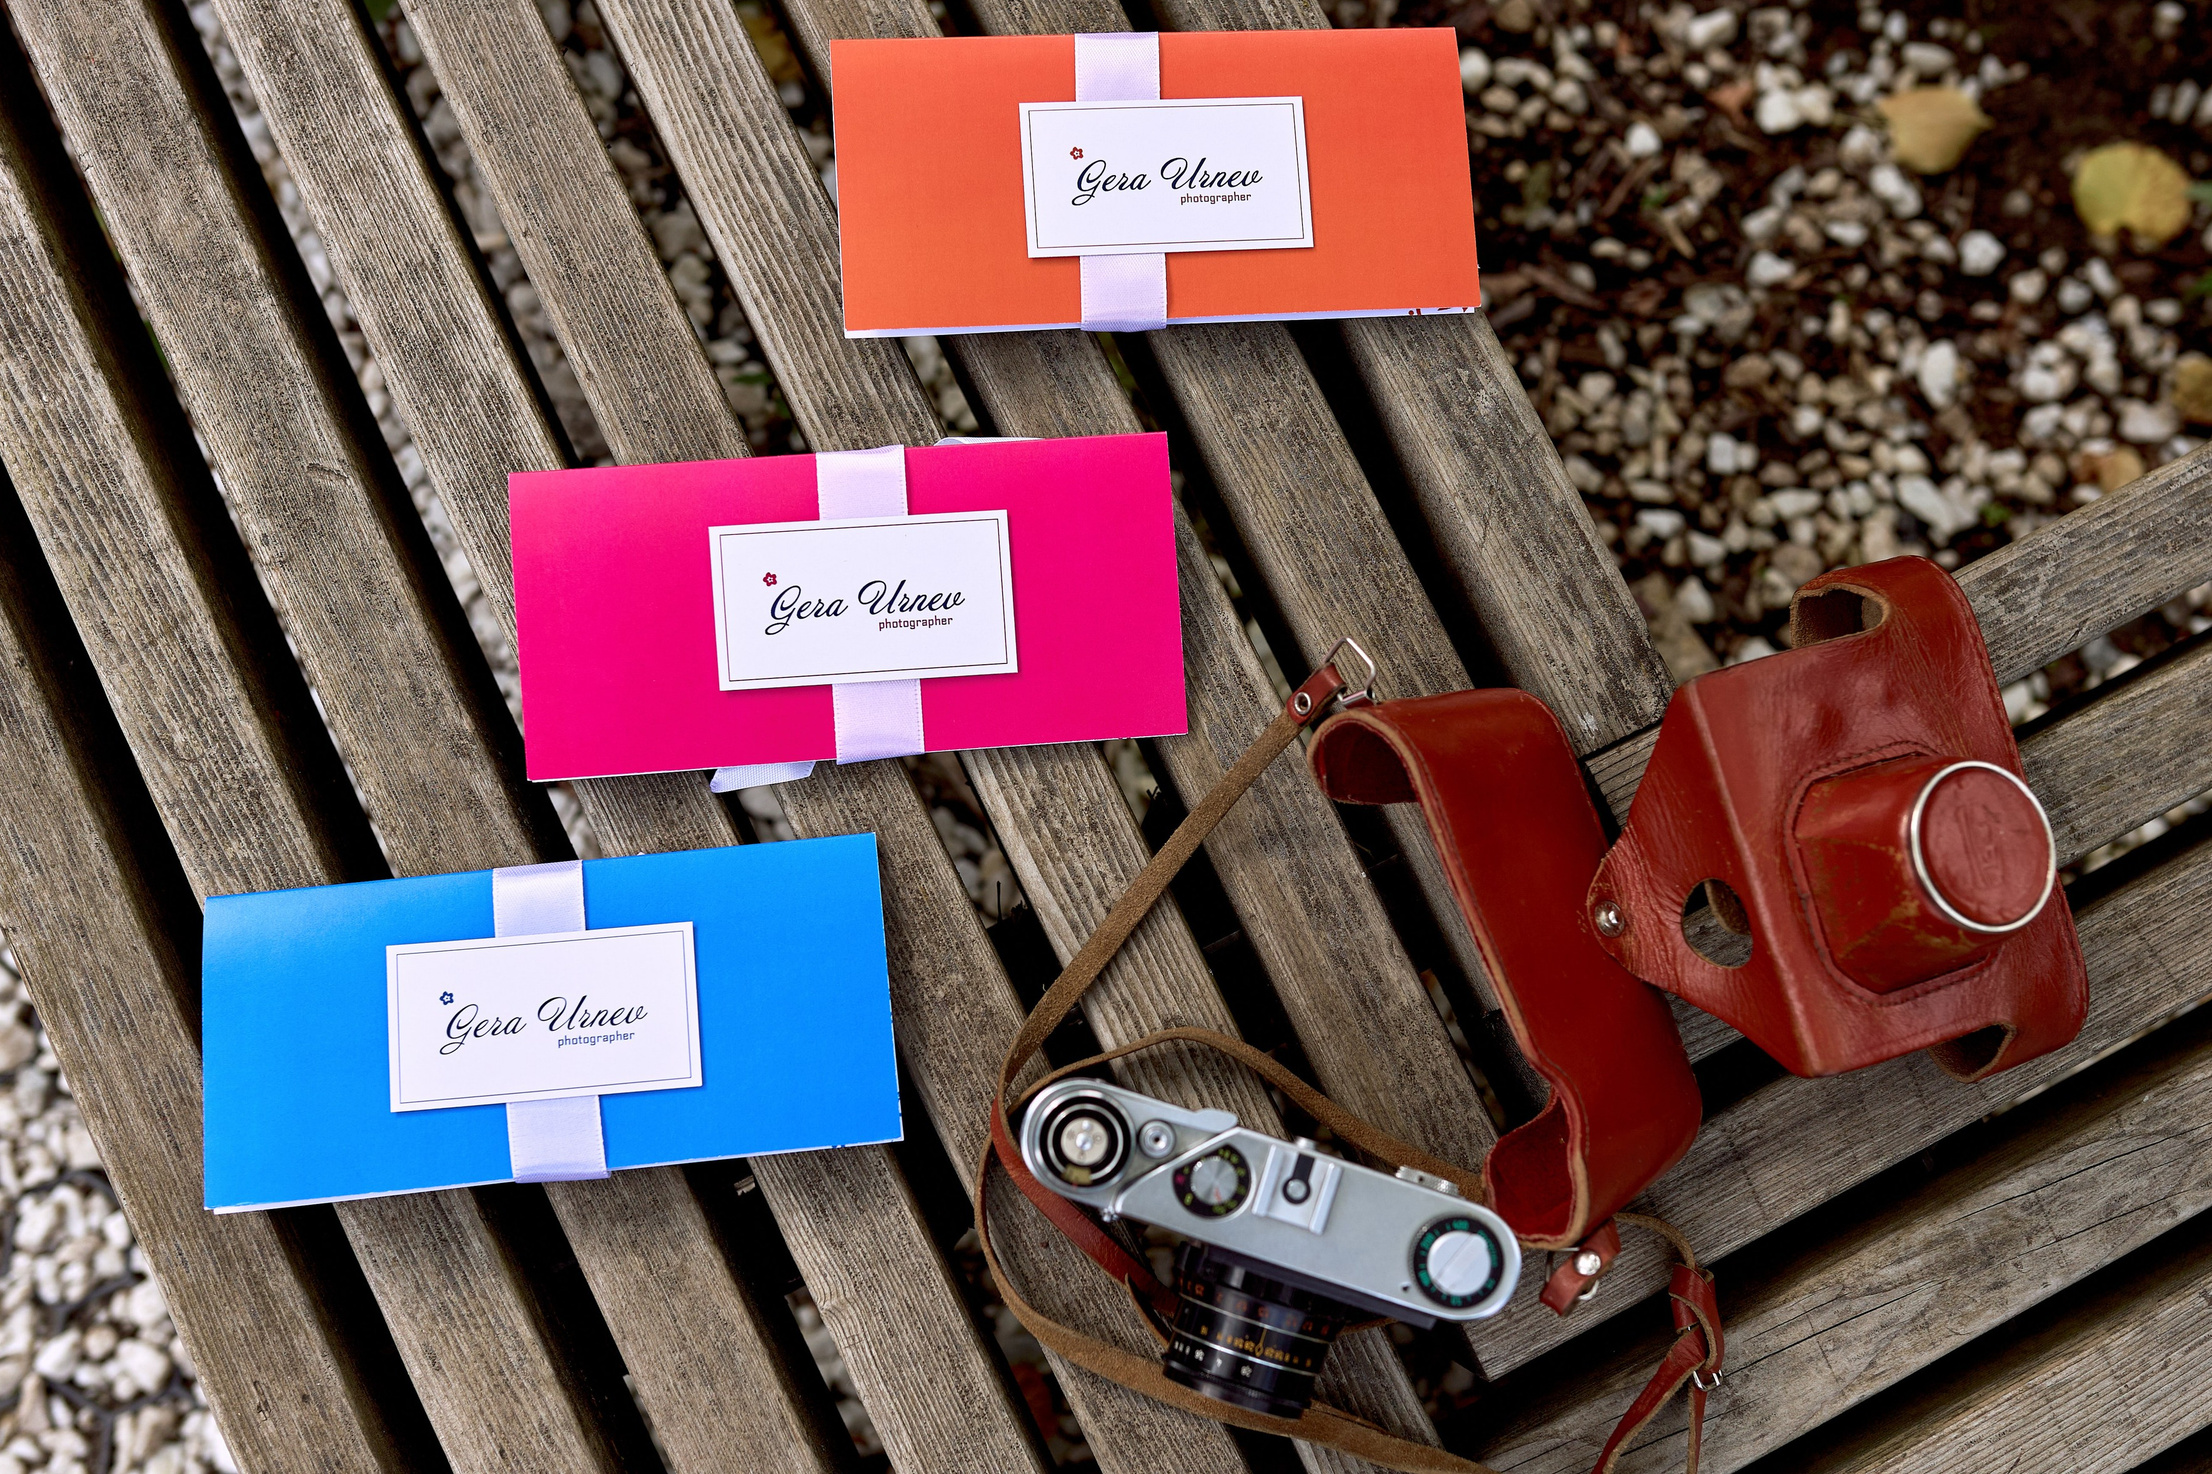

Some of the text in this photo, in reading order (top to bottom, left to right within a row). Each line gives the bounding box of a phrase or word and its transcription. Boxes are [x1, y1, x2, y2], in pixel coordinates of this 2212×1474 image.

[1072, 157, 1263, 206] Gera Urnev
[1180, 191, 1252, 205] photographer
[765, 579, 965, 635] Gera Urnev
[879, 615, 953, 631] photographer
[440, 995, 648, 1055] Gera Urnev
[558, 1031, 635, 1048] photographer
